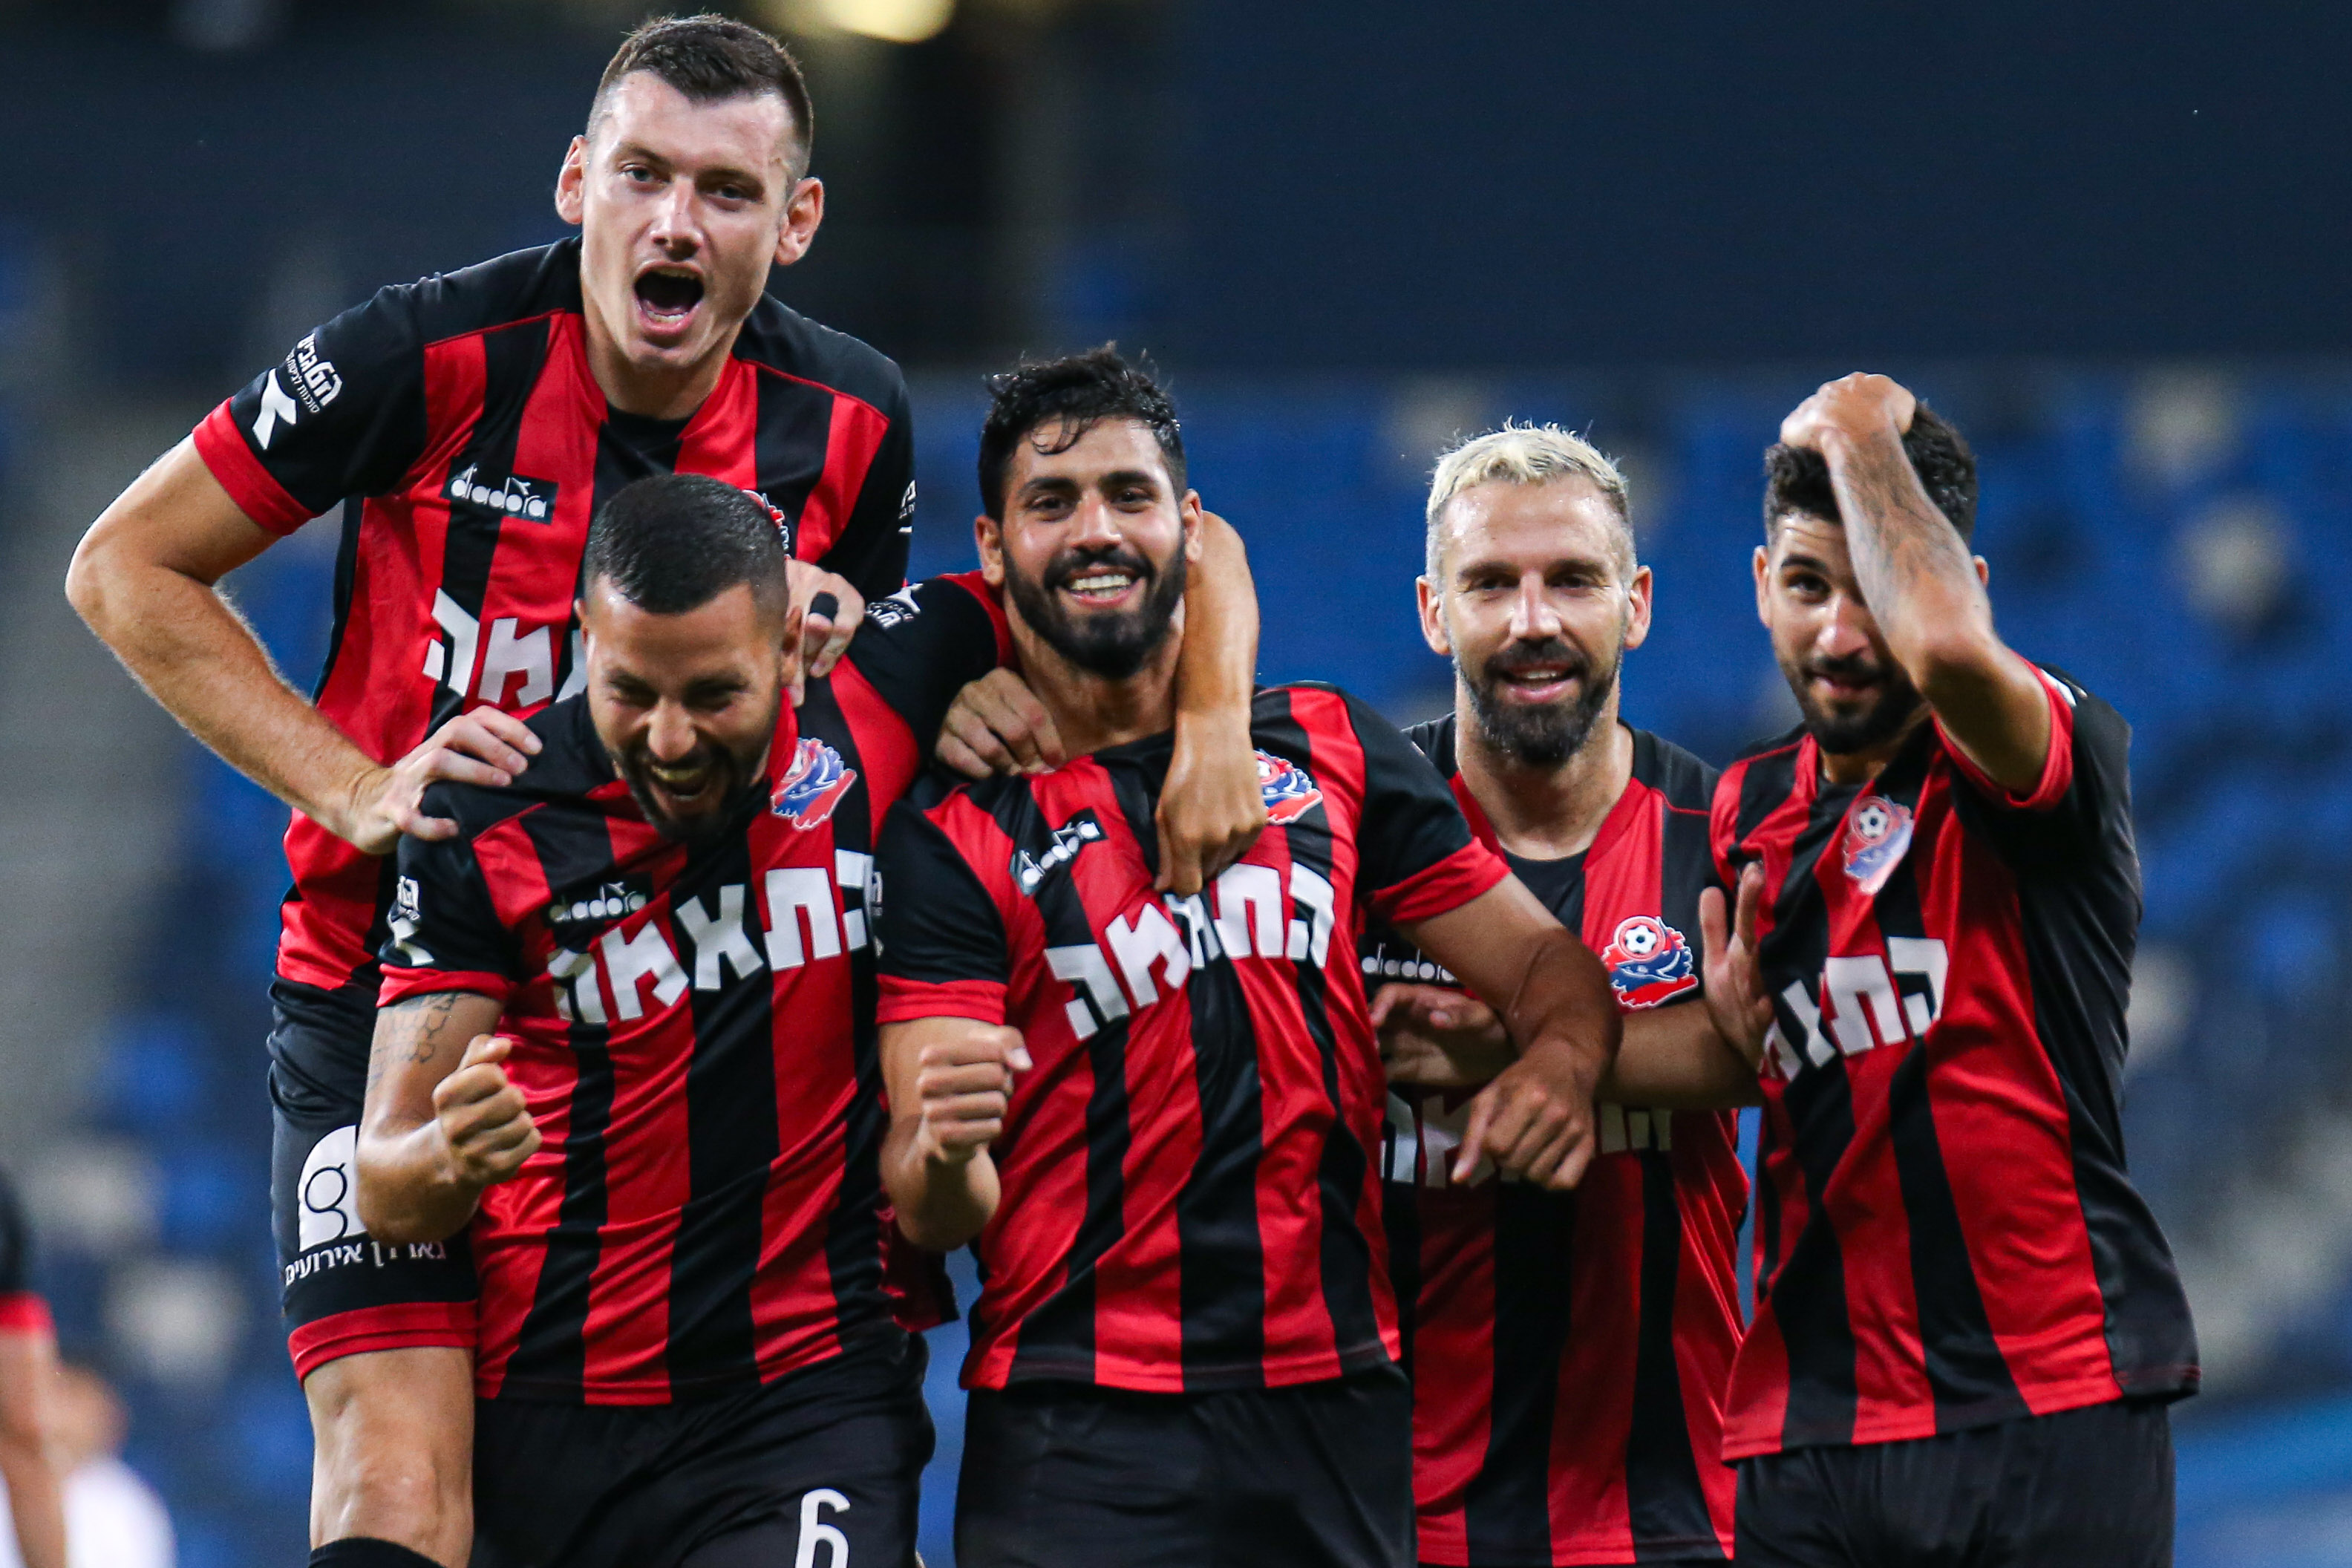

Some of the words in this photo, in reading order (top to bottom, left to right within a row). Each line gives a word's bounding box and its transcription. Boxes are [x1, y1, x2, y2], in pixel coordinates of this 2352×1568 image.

[450, 465, 548, 518] diadora
[284, 1241, 364, 1288] אירועים
[795, 1488, 851, 1568] 6
